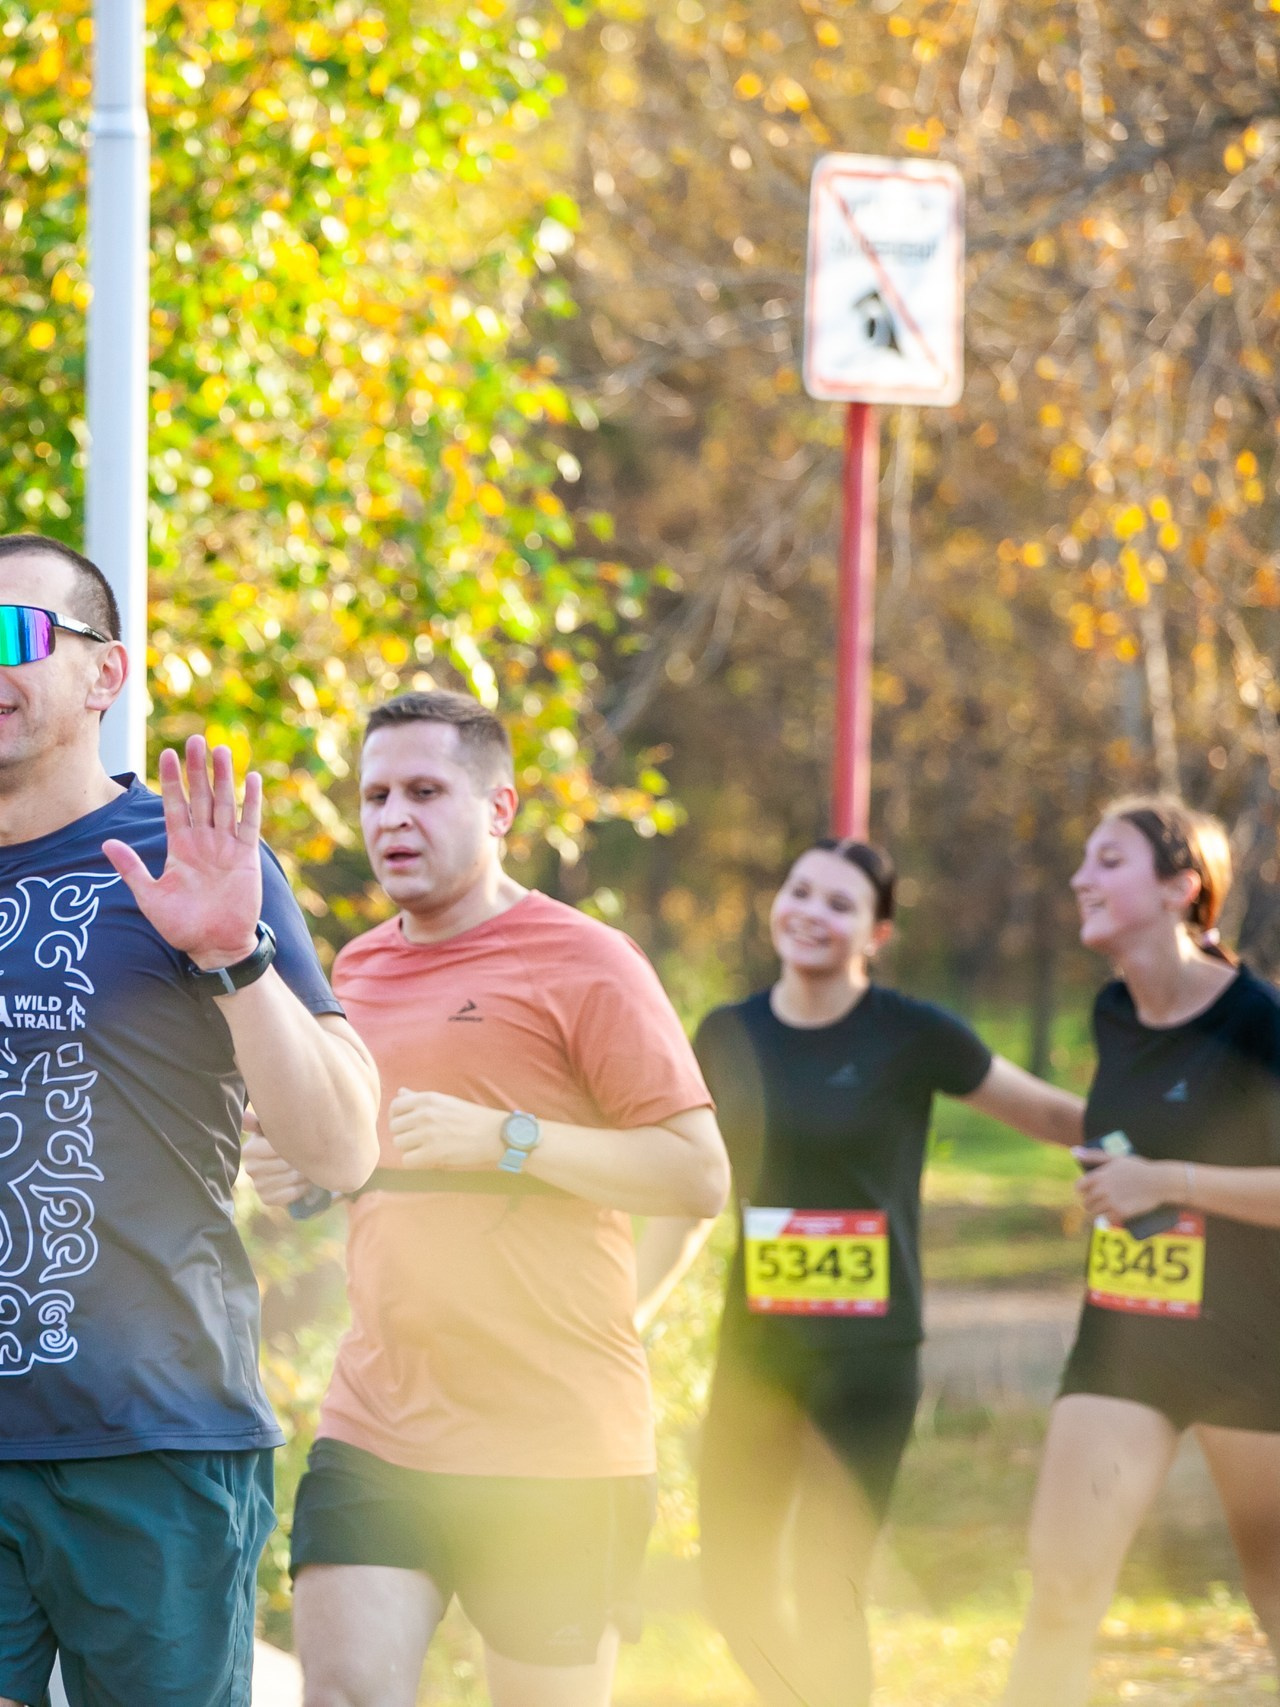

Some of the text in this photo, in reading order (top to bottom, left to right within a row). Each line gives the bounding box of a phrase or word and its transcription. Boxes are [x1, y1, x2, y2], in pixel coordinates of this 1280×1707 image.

[15, 995, 62, 1012] WILD
[13, 1013, 67, 1031] TRAIL
[757, 1242, 875, 1282] 5343
